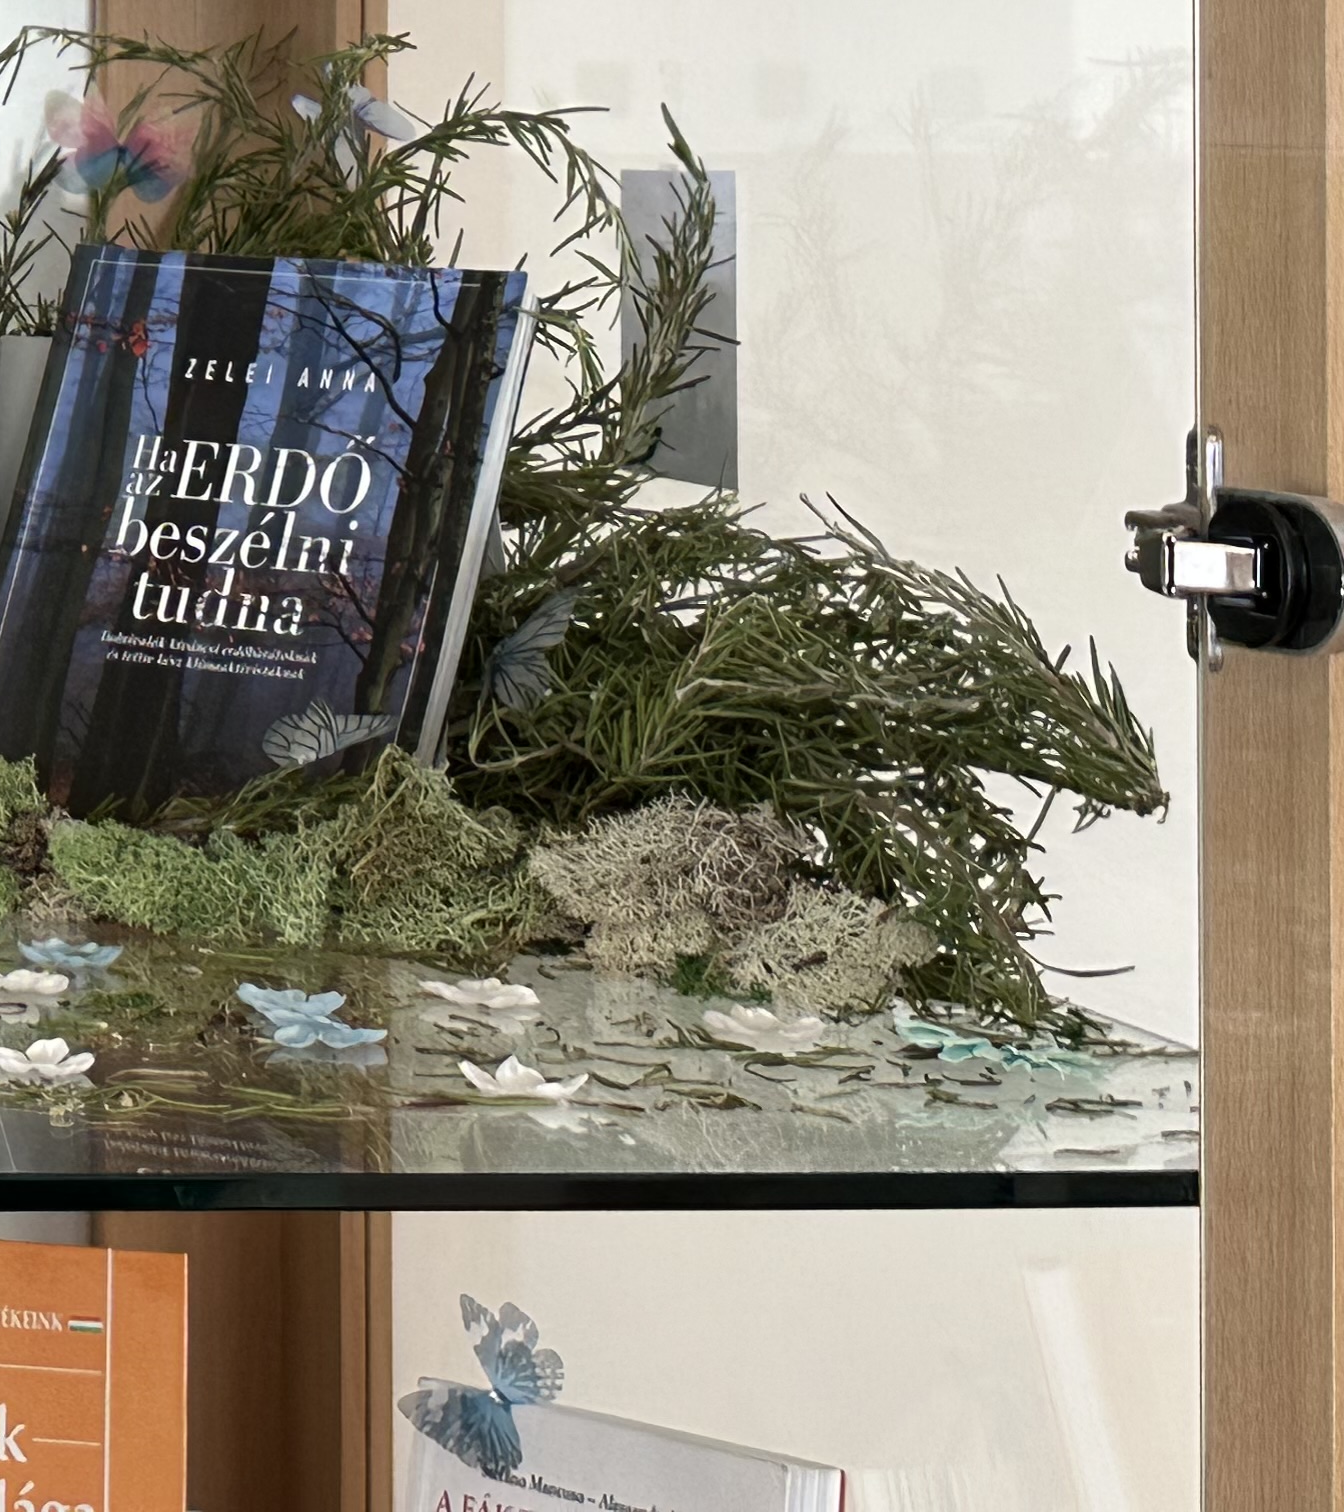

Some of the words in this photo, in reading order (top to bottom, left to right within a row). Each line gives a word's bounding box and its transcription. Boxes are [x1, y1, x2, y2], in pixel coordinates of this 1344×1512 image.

[184, 358, 273, 384] ZELEI
[297, 367, 377, 393] ANNA
[125, 471, 164, 497] az
[170, 435, 376, 514] ERDŐ
[132, 434, 177, 473] Ha
[109, 495, 358, 576] beszélni
[132, 567, 304, 636] tudna
